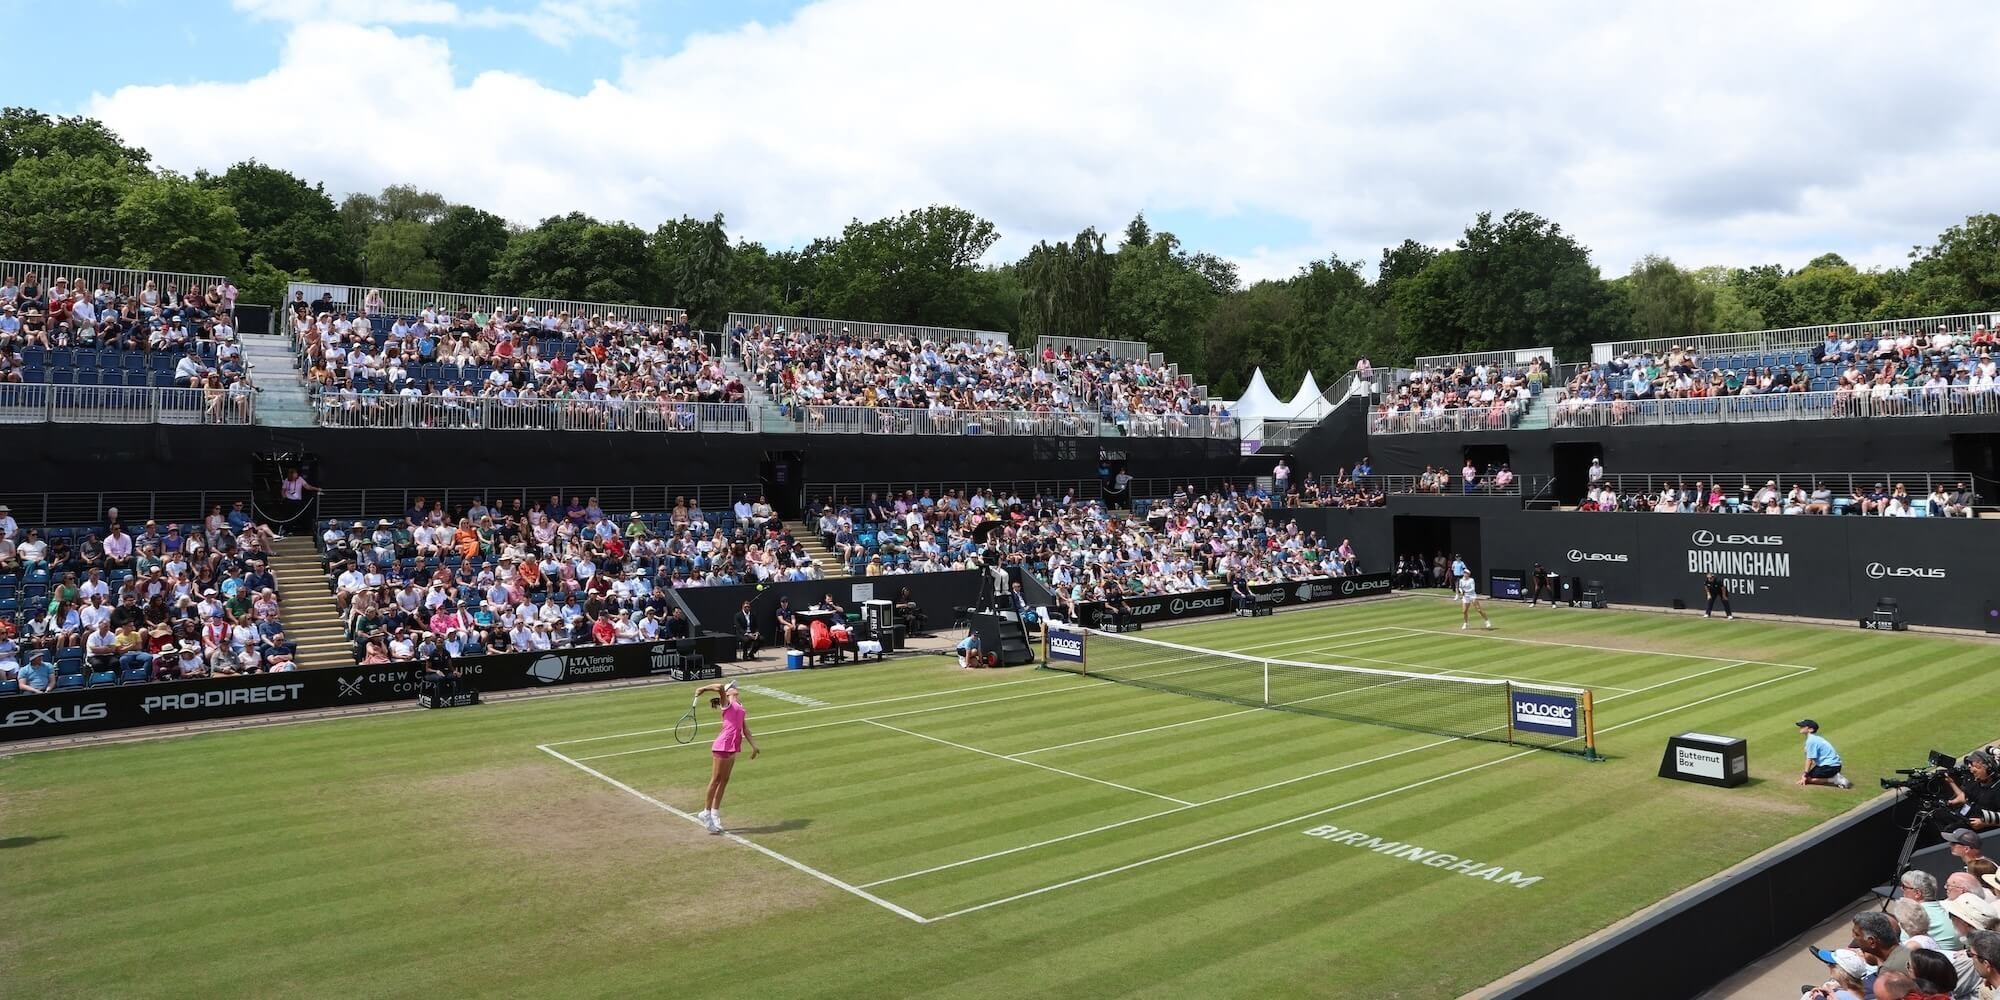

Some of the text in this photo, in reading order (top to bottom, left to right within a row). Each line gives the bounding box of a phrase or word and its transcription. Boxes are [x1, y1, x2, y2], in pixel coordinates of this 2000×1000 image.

[1715, 534, 1783, 546] LEXUS
[1583, 553, 1628, 562] LEXUS
[1687, 549, 1790, 577] BIRMINGHAM
[1886, 567, 1946, 578] LEXUS
[1354, 579, 1390, 591] LEXUS
[1185, 597, 1225, 609] LEXUS
[1051, 636, 1081, 650] HOLOGIC
[569, 654, 614, 667] LTA Tennis
[569, 664, 614, 676] Foundation
[368, 671, 408, 684] CREW
[141, 683, 305, 714] PRO:DIRECT
[0, 702, 108, 728] EXUS
[1516, 701, 1573, 719] HOLOGIC
[1679, 750, 1721, 764] Butternut
[1679, 758, 1694, 768] Box
[1301, 825, 1545, 889] BIRMINGHAM
